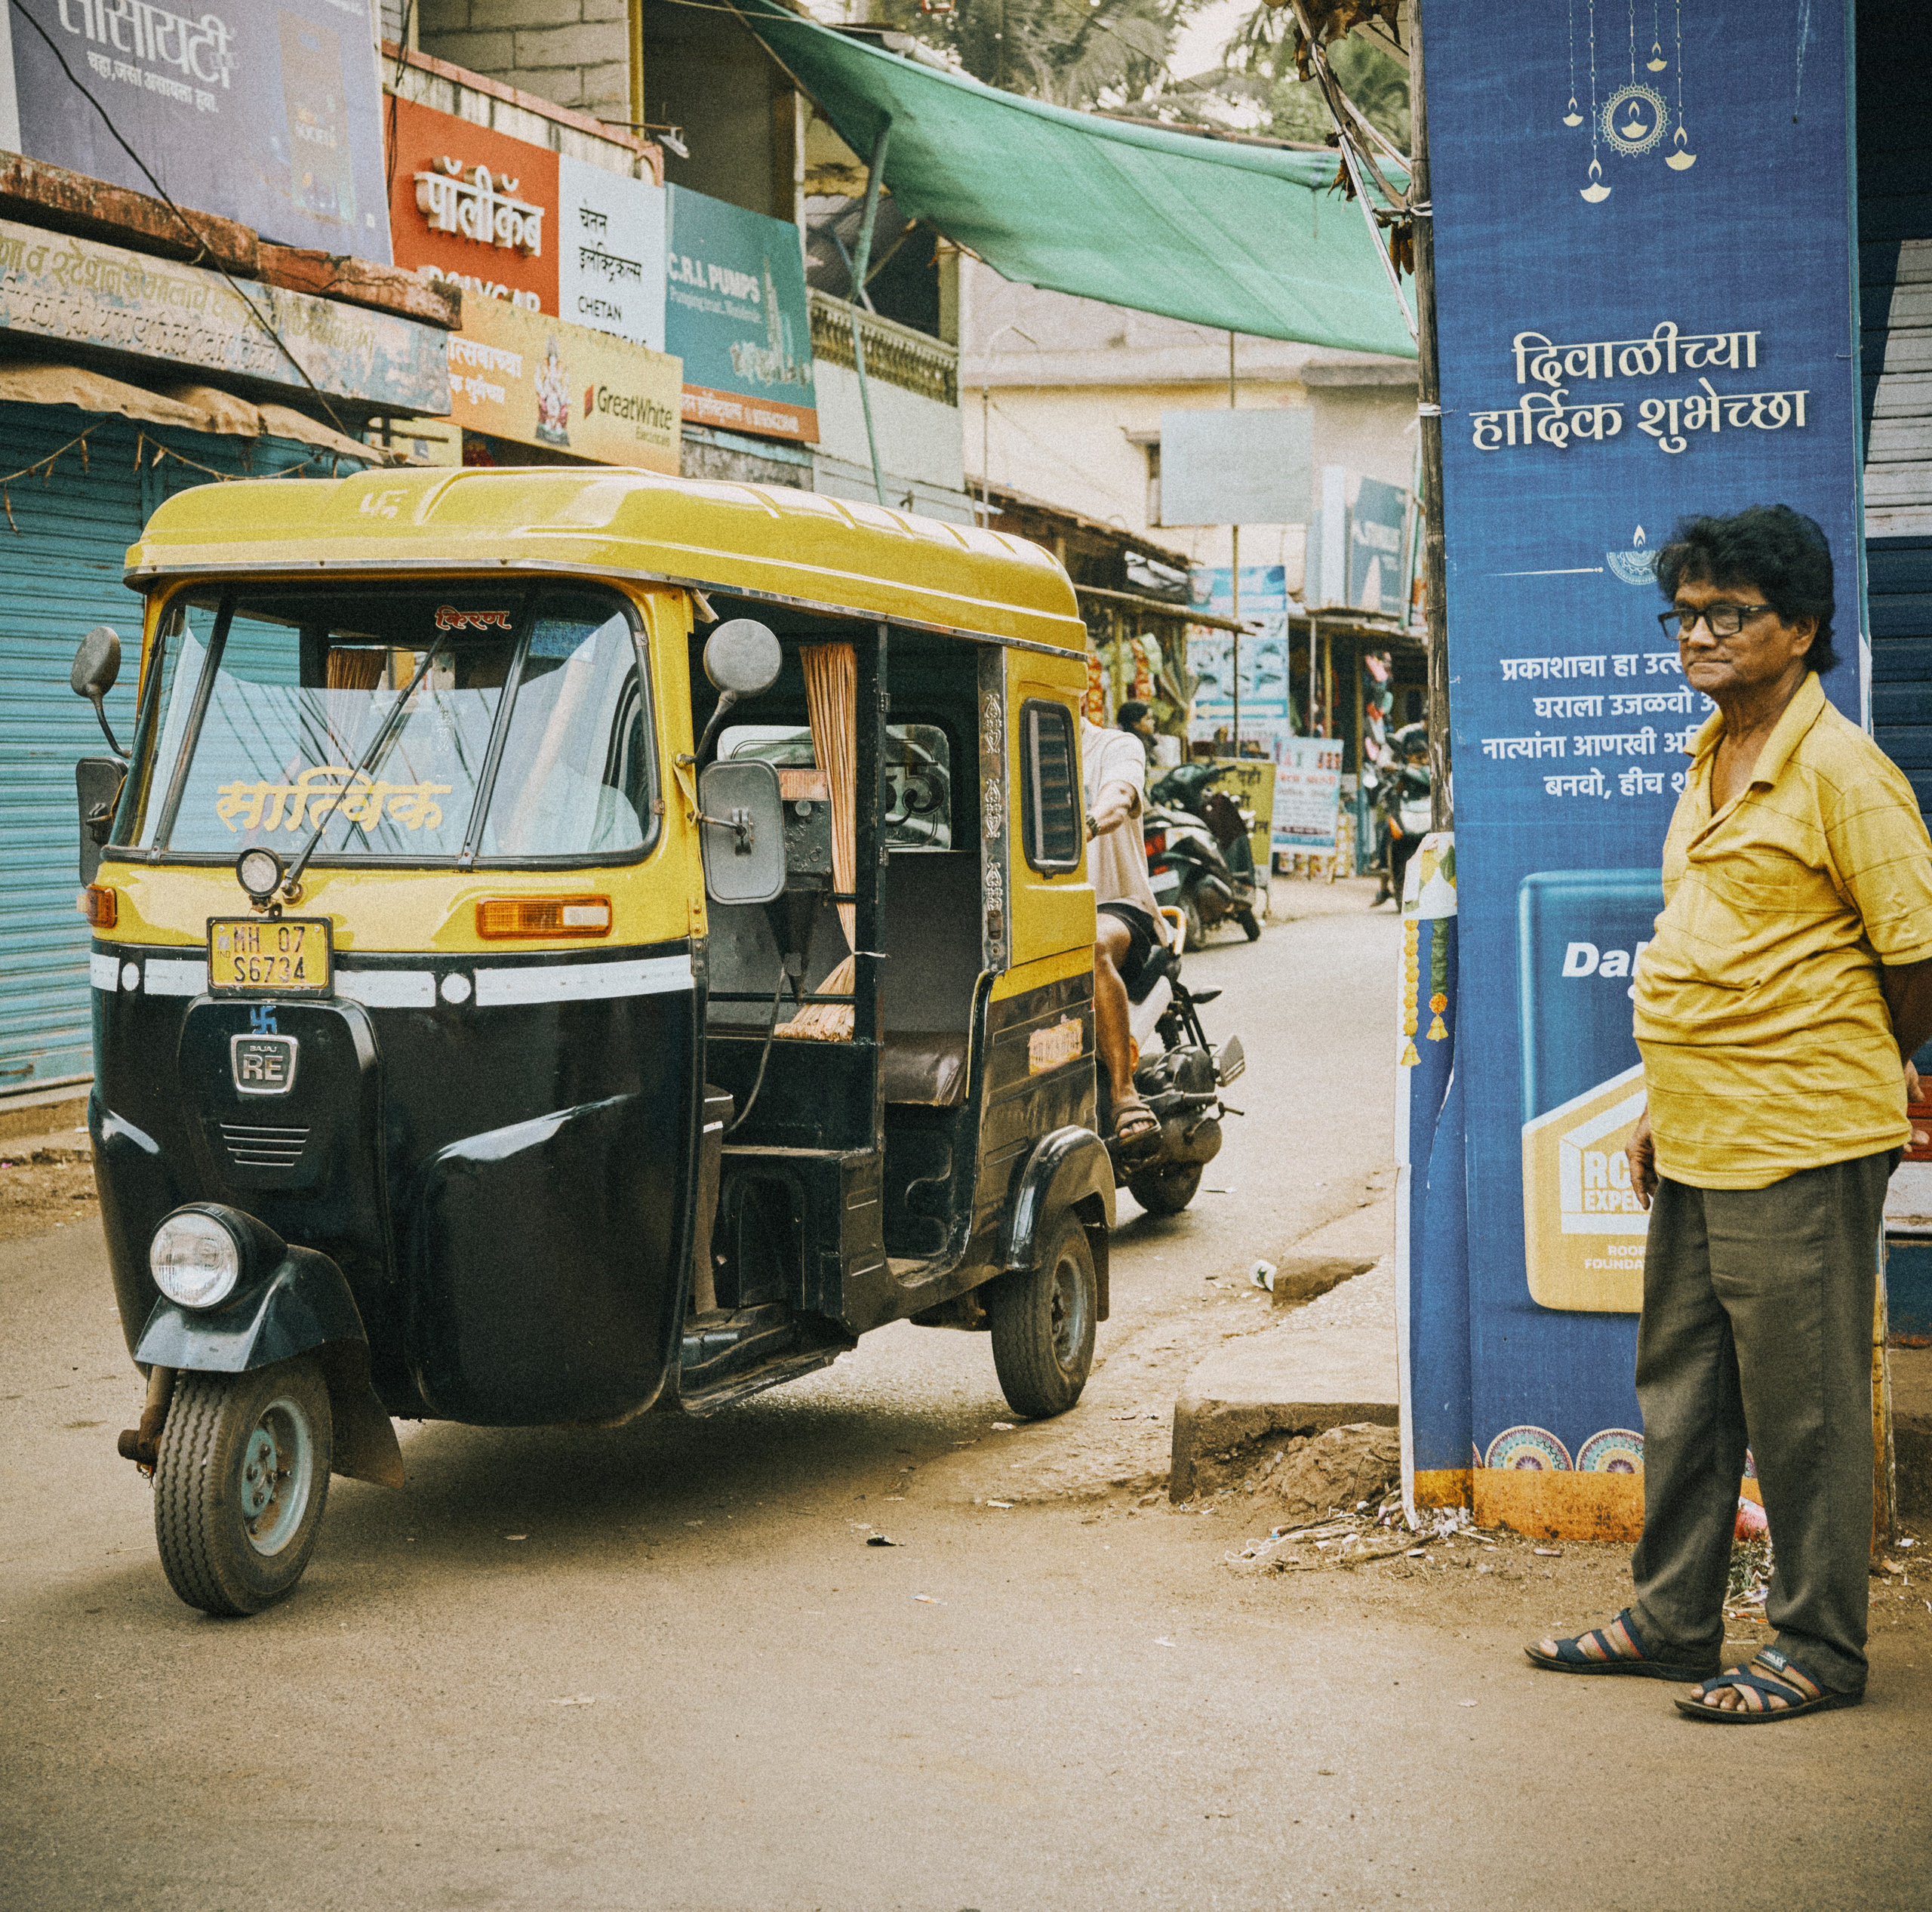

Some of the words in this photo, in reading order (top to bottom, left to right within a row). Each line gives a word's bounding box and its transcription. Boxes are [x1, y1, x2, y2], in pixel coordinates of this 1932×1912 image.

[708, 263, 760, 303] PUMPS
[577, 295, 623, 322] CHETAN
[1512, 321, 1761, 386] दिवाळीच्या
[1469, 389, 1624, 450] हार्दिक
[1637, 377, 1809, 454] शुभेच्छा
[435, 605, 512, 630] किरण
[1500, 655, 1607, 680] प्रकाशाचा
[1611, 654, 1638, 676] हा
[1644, 653, 1683, 674] उत्स
[1533, 695, 1604, 719] घराला
[1609, 685, 1694, 716] उजळवो
[1481, 731, 1567, 759] नात्यांना
[1573, 725, 1657, 756] आणखी
[1543, 768, 1612, 799] बनवो,
[1618, 766, 1664, 796] हीच
[216, 766, 452, 833] सात्विक
[233, 926, 260, 953] MH
[278, 926, 305, 953] 07
[234, 956, 305, 983] S6734
[1561, 941, 1649, 978] Dal
[242, 1055, 283, 1081] RE
[1584, 1259, 1644, 1270] FOUNDA
